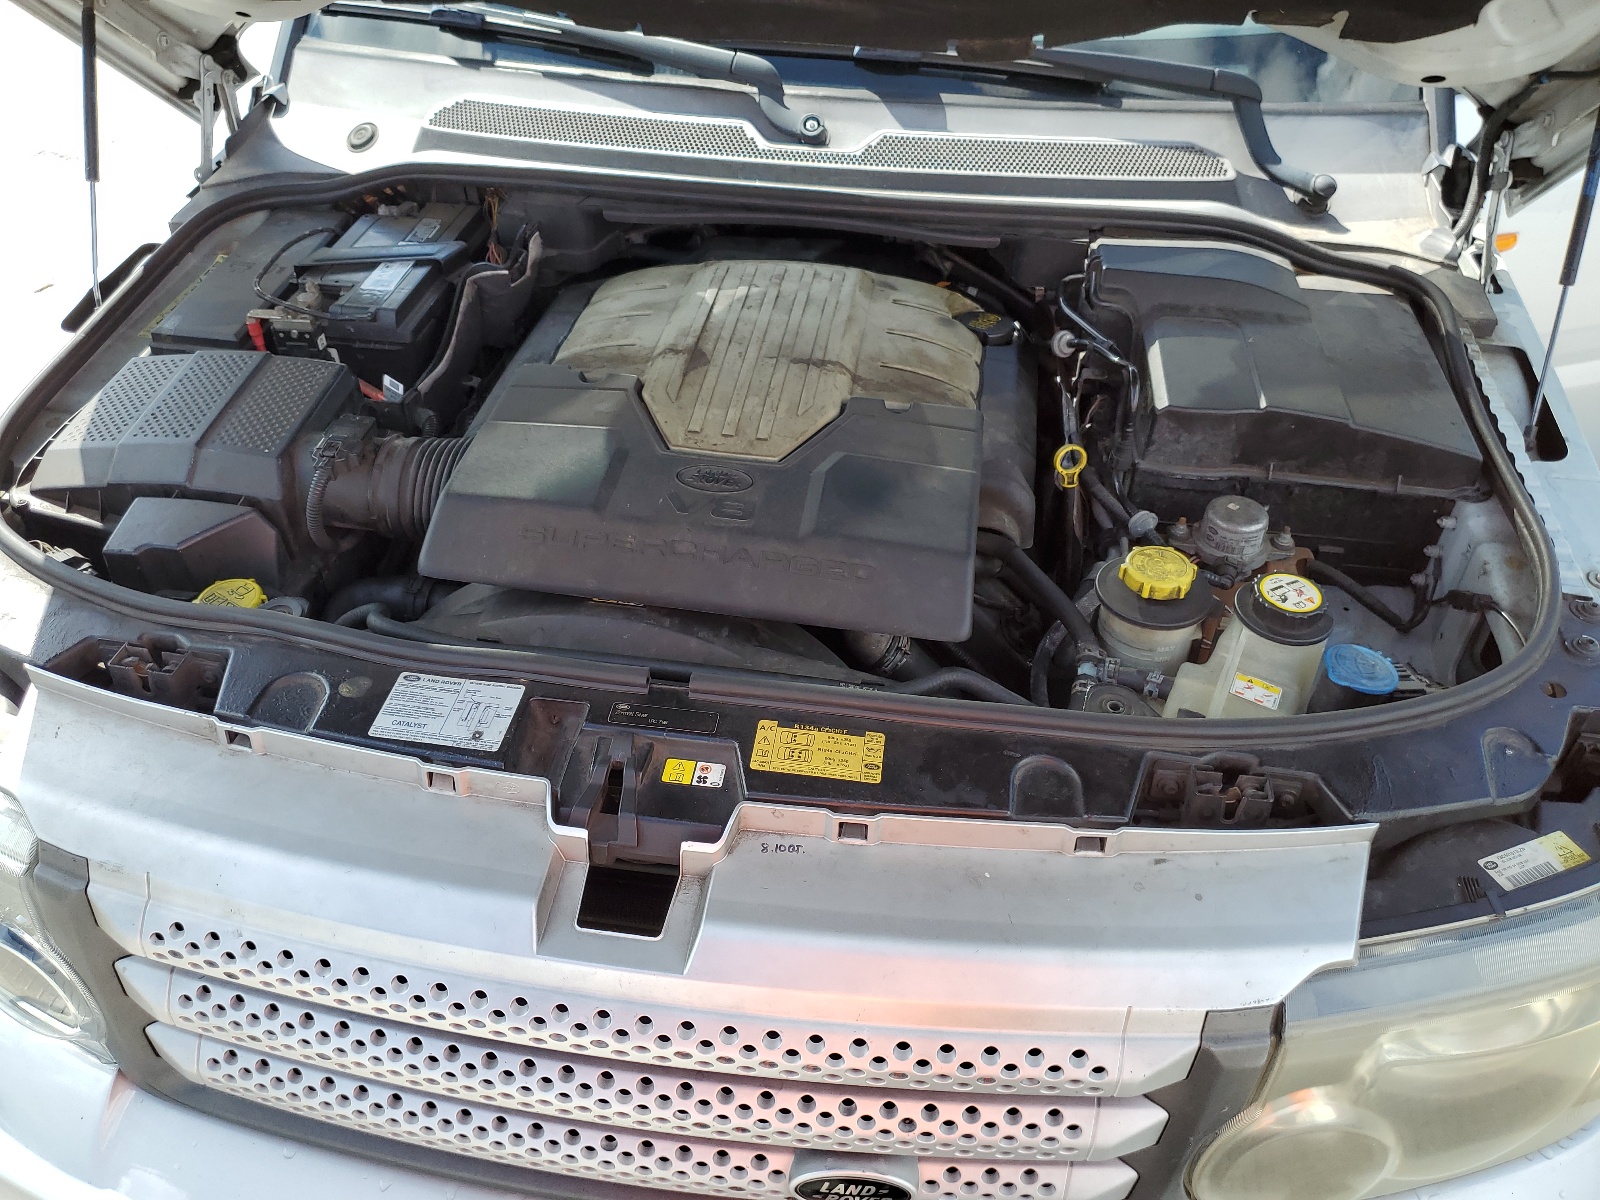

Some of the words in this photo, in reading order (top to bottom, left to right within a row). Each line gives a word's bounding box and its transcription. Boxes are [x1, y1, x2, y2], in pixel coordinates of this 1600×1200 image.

[698, 474, 741, 489] ROVER
[664, 492, 756, 522] V8
[519, 526, 876, 585] SUPERCHARGED
[391, 719, 428, 730] CATALYST
[819, 1181, 877, 1195] LAND
